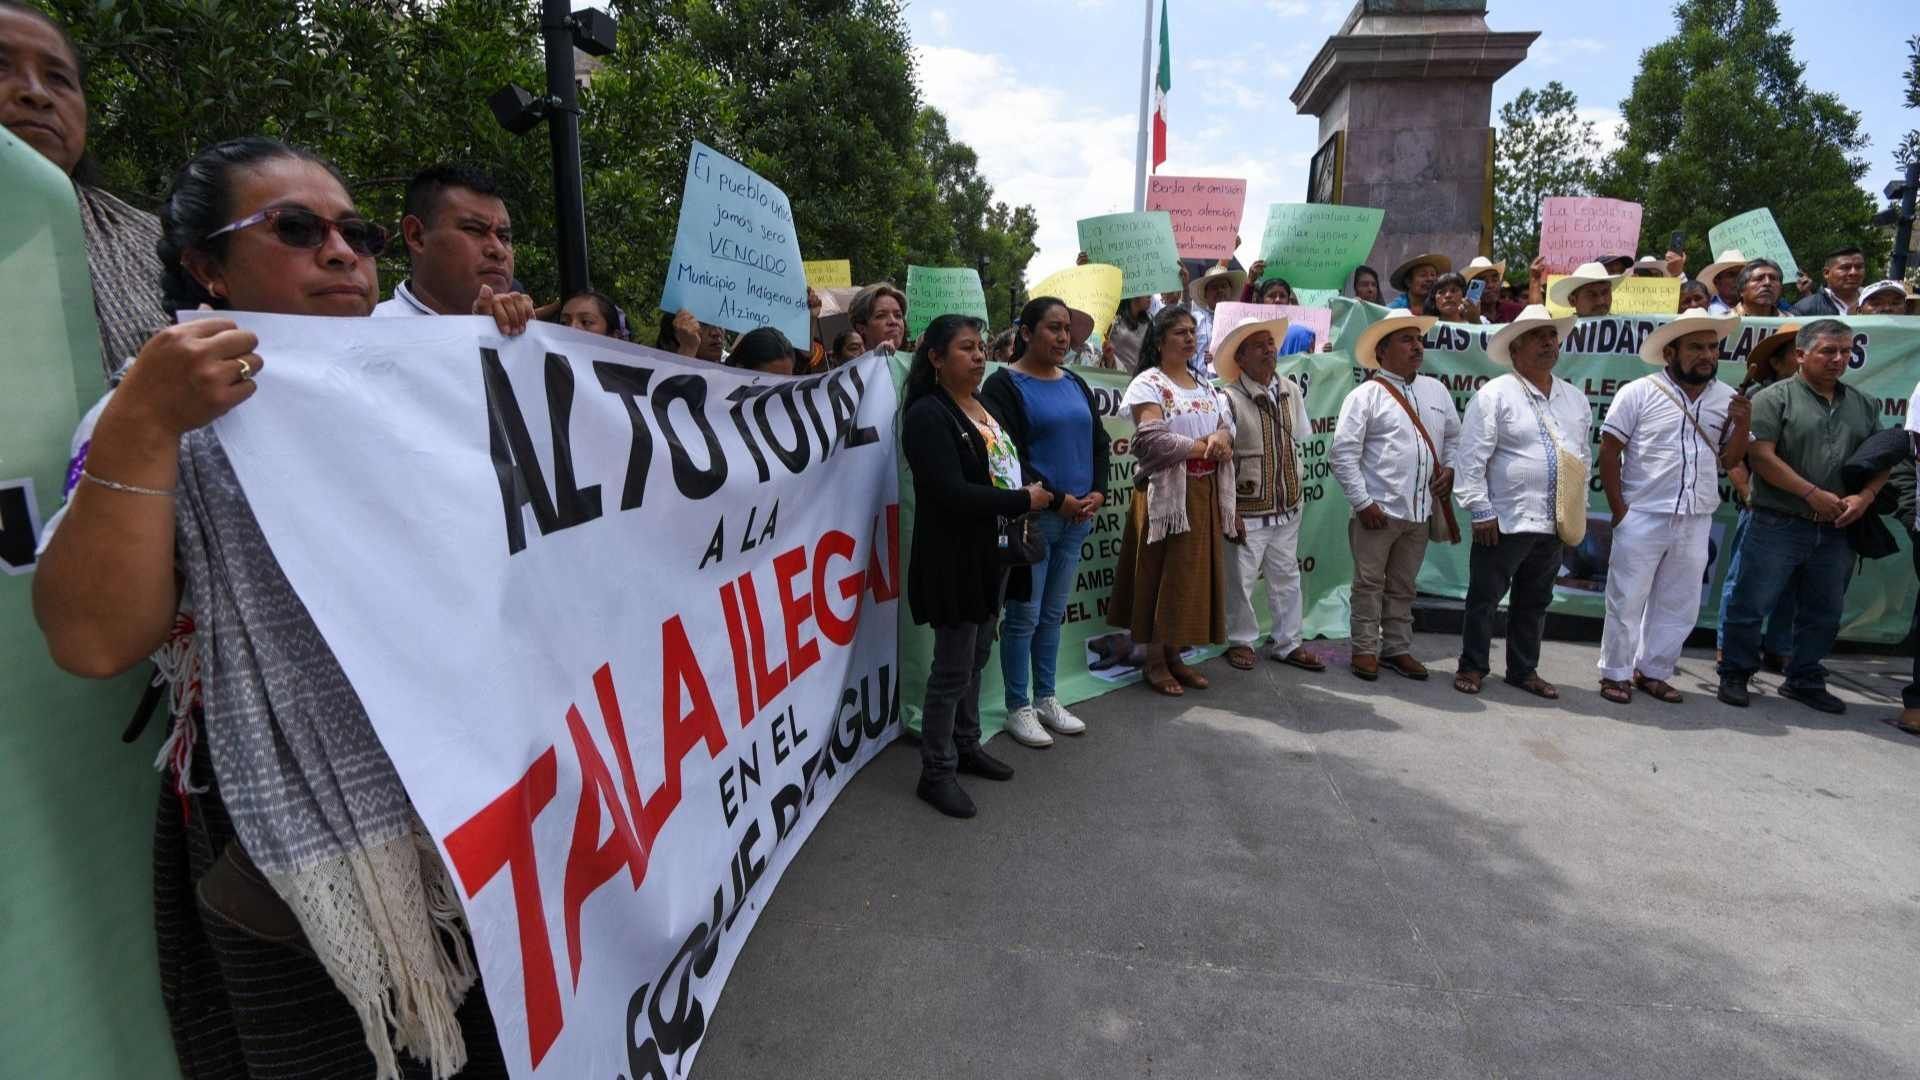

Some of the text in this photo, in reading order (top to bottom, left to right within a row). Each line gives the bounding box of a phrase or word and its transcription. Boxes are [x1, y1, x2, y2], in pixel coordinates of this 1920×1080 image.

[694, 152, 710, 184] El
[677, 263, 736, 293] Municipio
[709, 231, 787, 275] VENCIDO
[718, 295, 770, 328] Atzingo
[479, 346, 881, 556] ALTO TOTAL
[698, 497, 779, 570] A LA
[719, 703, 808, 829] EN EL
[445, 613, 728, 1072] TALA
